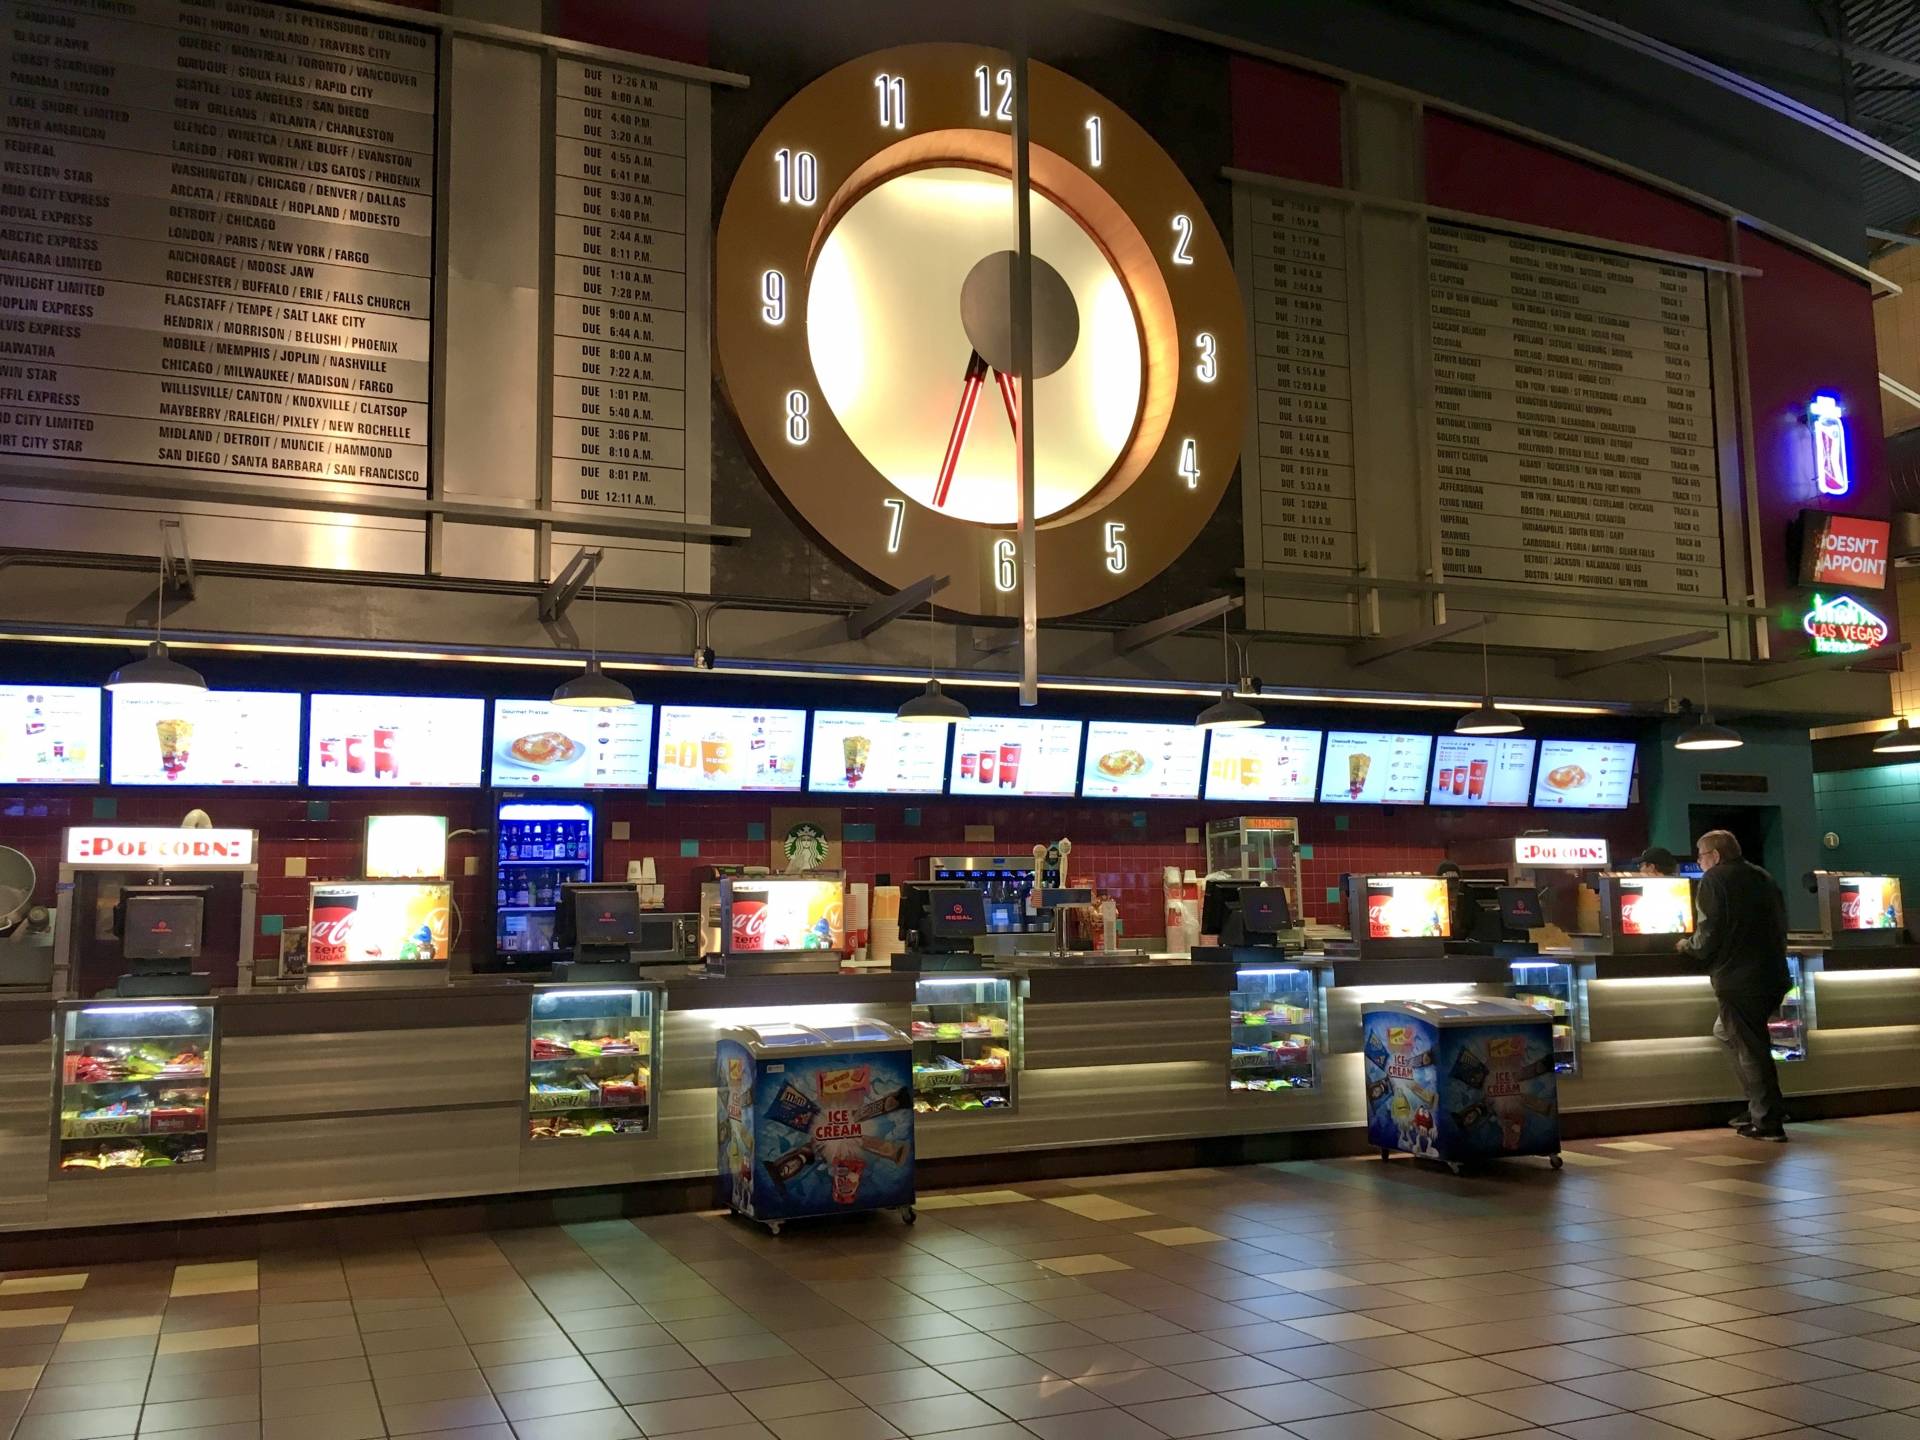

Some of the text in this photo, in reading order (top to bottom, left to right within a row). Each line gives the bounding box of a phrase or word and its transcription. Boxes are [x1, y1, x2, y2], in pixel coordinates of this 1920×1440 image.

[584, 68, 660, 91] DUE 12:26 A.M.
[976, 66, 1012, 121] 12
[875, 75, 906, 128] 11
[207, 103, 256, 121] ORLEANS
[269, 112, 315, 130] ATLANTA
[326, 121, 394, 142] CHARLESTON
[583, 123, 654, 146] DUE 3:20 A.M.
[4, 139, 56, 156] FEDERAL
[1087, 117, 1101, 166] 1
[3, 160, 92, 183] WESTERN STAR
[172, 140, 420, 188] LAREDO FORT WORTH LOS GATOS PHOENIX
[776, 149, 817, 206] 10
[171, 164, 406, 207] WASHINGTON CHICAGO DENVER DALLAS
[583, 185, 654, 206] DUE 9:30 A.M.
[0, 204, 92, 226] ROYAL EXPRESS
[170, 184, 399, 227] ARCATA FERNDALE HOPLAND MODESTO
[168, 227, 368, 264] LONDON PARIS NEW YORK FARGO
[583, 242, 651, 262] DUE 8:11 P.M.
[1173, 216, 1194, 264] 2
[55, 255, 102, 271] LIMITED
[168, 250, 314, 278] ANCHORAGE MOOSE JAW
[166, 271, 410, 311] ROCHESTER BUFFALO ERIE FALLS CHURCH
[763, 272, 785, 324] 9
[165, 293, 365, 328] FLAGSTAFF TEMPE SALT LAKE CITY
[582, 303, 653, 324] DUE 9:00 A.M.
[164, 315, 213, 331] HENDRIX
[224, 322, 284, 339] MORRISON
[352, 337, 397, 353] PHOENIX
[163, 337, 386, 372] MOBILE MEMPHIS JOPLIN NASHVILLE
[1197, 333, 1217, 382] 3
[162, 358, 213, 374] CHICAGO
[297, 372, 348, 389] MADISON
[358, 379, 393, 393] FARGO
[582, 362, 654, 381] DUE 7:22 A.M.
[236, 389, 282, 404] CANTON
[292, 395, 349, 411] KNOXVILLE
[360, 402, 407, 417] CLATSOP
[581, 403, 653, 420] DUE 5:40 A.M.
[787, 391, 809, 444] 8
[160, 403, 220, 420] MAYBERRY
[283, 415, 318, 429] PIXLEY
[329, 420, 353, 433] NEW
[357, 423, 411, 438] ROCHELLE
[159, 426, 392, 459] MIDLAND DETROIT MUNCIE HAMMOND
[158, 448, 418, 482] SAN DIEGO SANTA BARBARA SAN FRANCISCO
[1179, 440, 1199, 488] 4
[580, 489, 656, 504] DUE 12:11 A.M.
[885, 500, 905, 552] 7
[1283, 533, 1296, 542] DUE
[1106, 523, 1127, 573] 5
[995, 540, 1015, 591] 6
[1813, 623, 1882, 642] LAS VEGAS
[314, 945, 346, 955] zero
[735, 935, 760, 943] zero
[1388, 1066, 1413, 1077] CREAM
[1394, 1055, 1406, 1066] ICE
[1495, 1072, 1511, 1082] ICE
[1487, 1084, 1521, 1097] CREAM
[815, 1123, 862, 1139] CREAM
[828, 1110, 849, 1124] ICE
